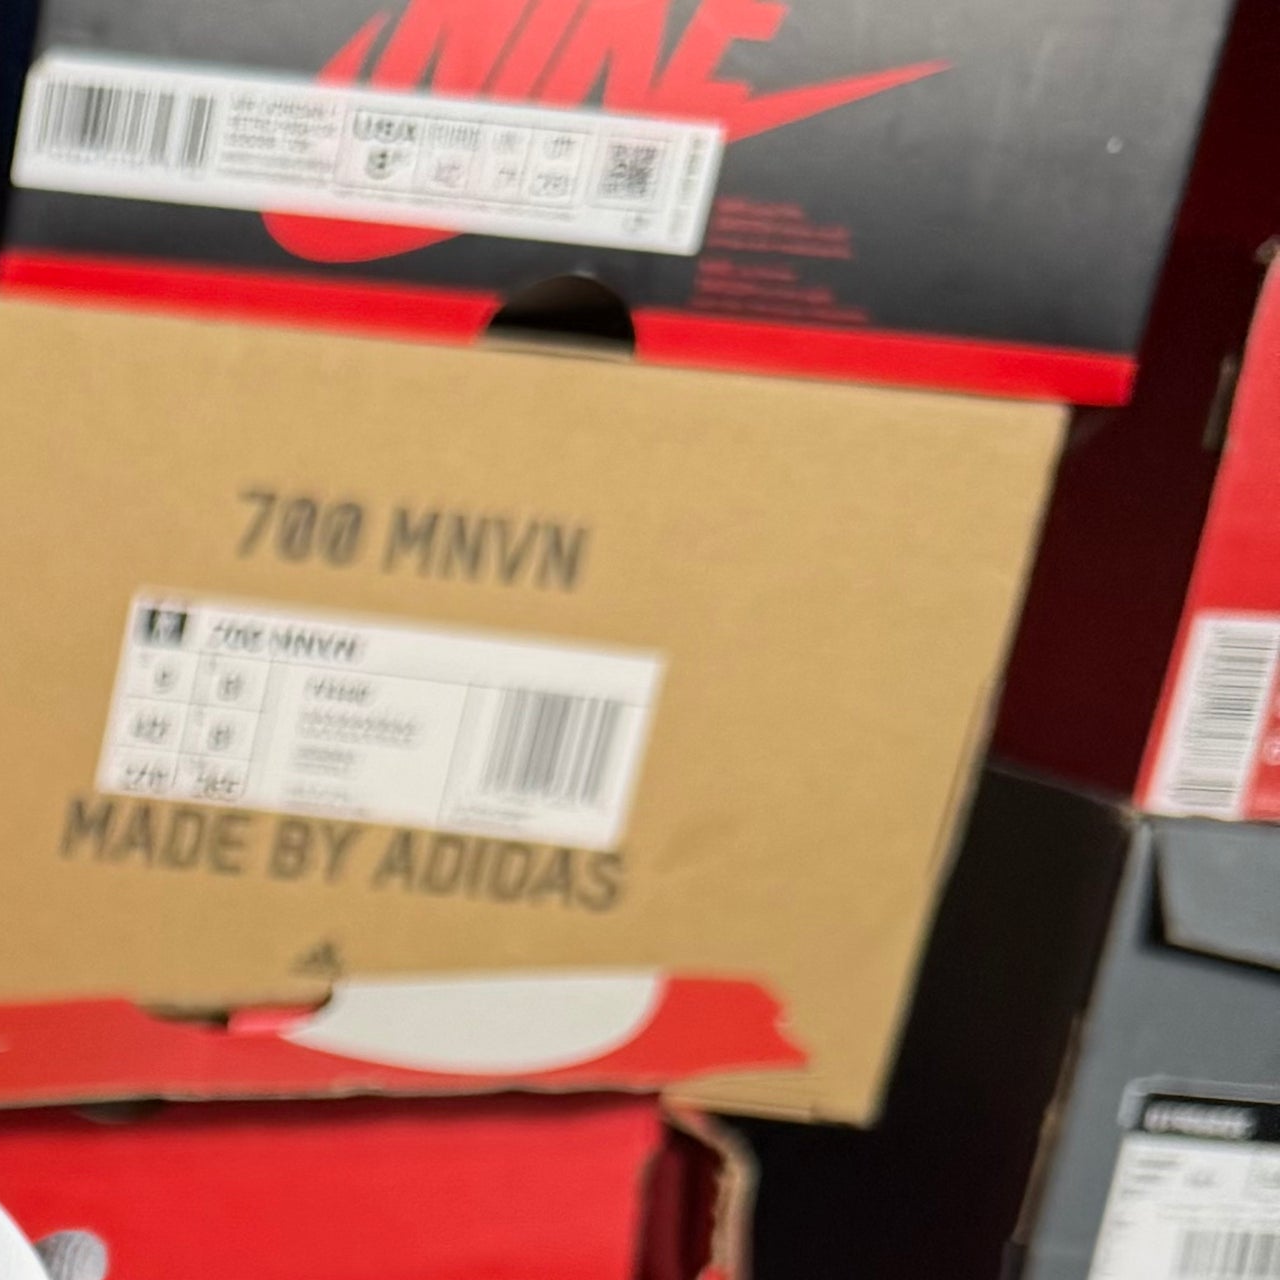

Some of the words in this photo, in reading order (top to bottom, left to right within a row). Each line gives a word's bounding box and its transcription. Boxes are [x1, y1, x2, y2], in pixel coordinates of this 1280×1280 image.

[236, 488, 364, 571] 700
[382, 505, 592, 596] MNVN
[60, 796, 248, 878] MADE
[266, 813, 362, 886] BY
[372, 826, 622, 914] ADIDAS
